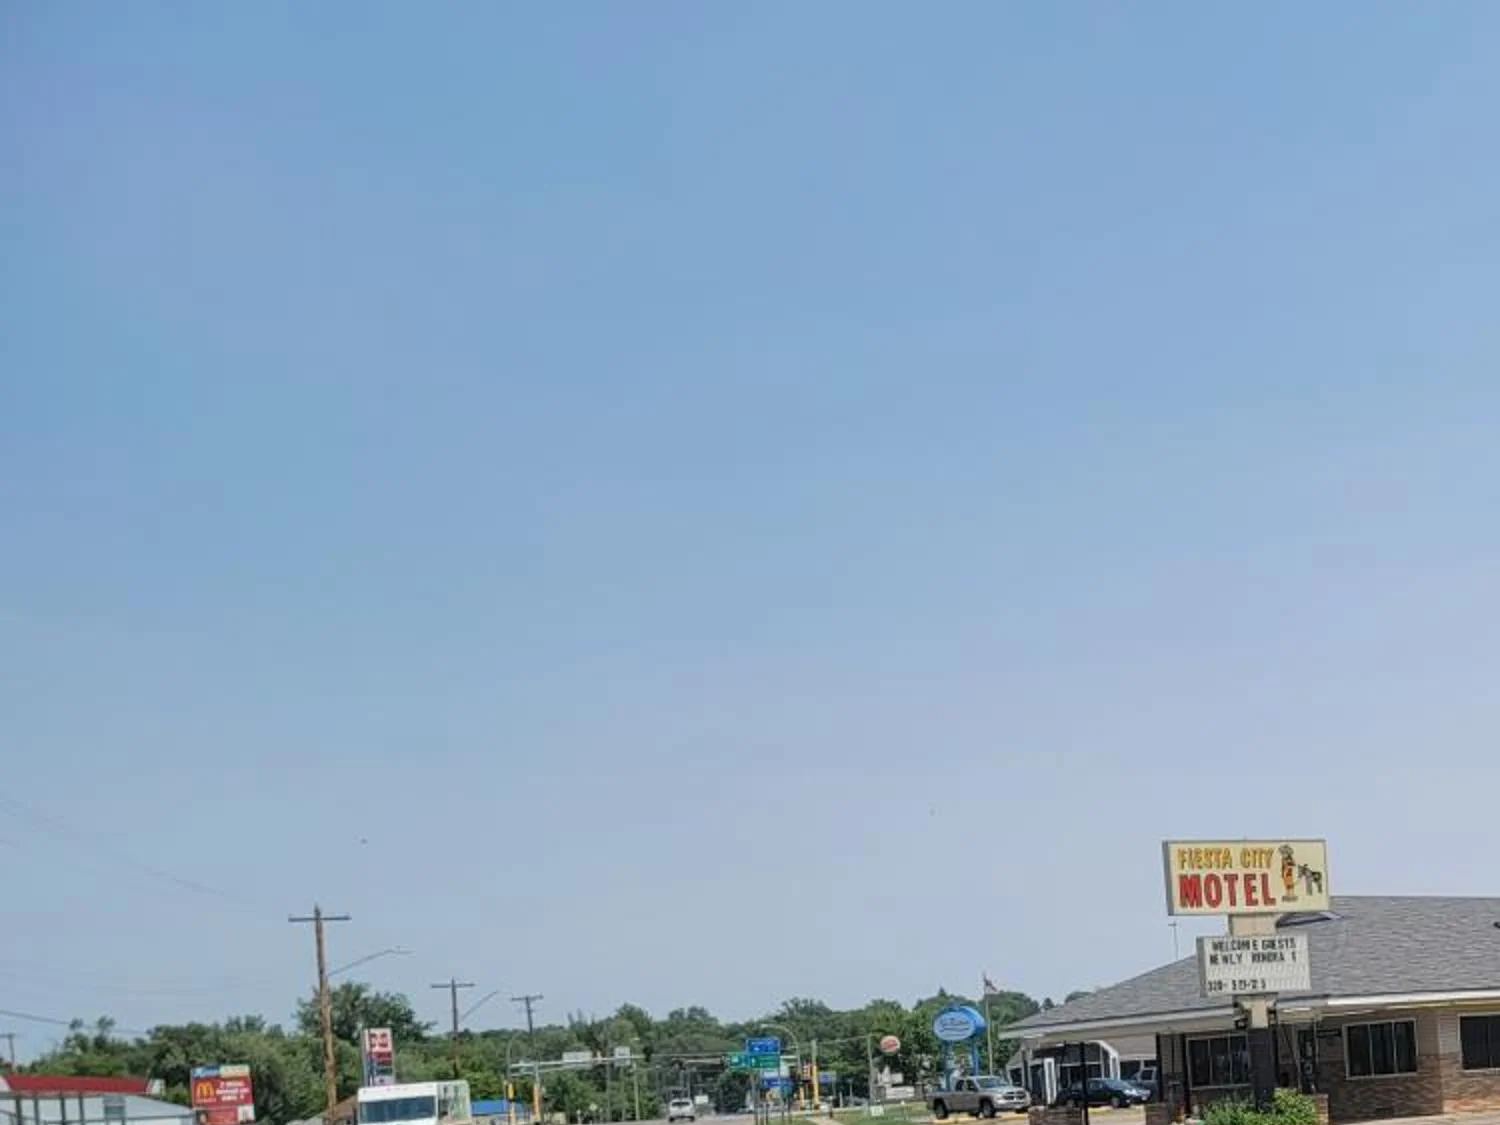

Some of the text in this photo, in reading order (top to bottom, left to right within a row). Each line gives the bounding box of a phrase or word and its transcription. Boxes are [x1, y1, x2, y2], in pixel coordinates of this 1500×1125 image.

[1177, 848, 1274, 869] FIESTA CITY
[1179, 873, 1276, 908] MOTEL
